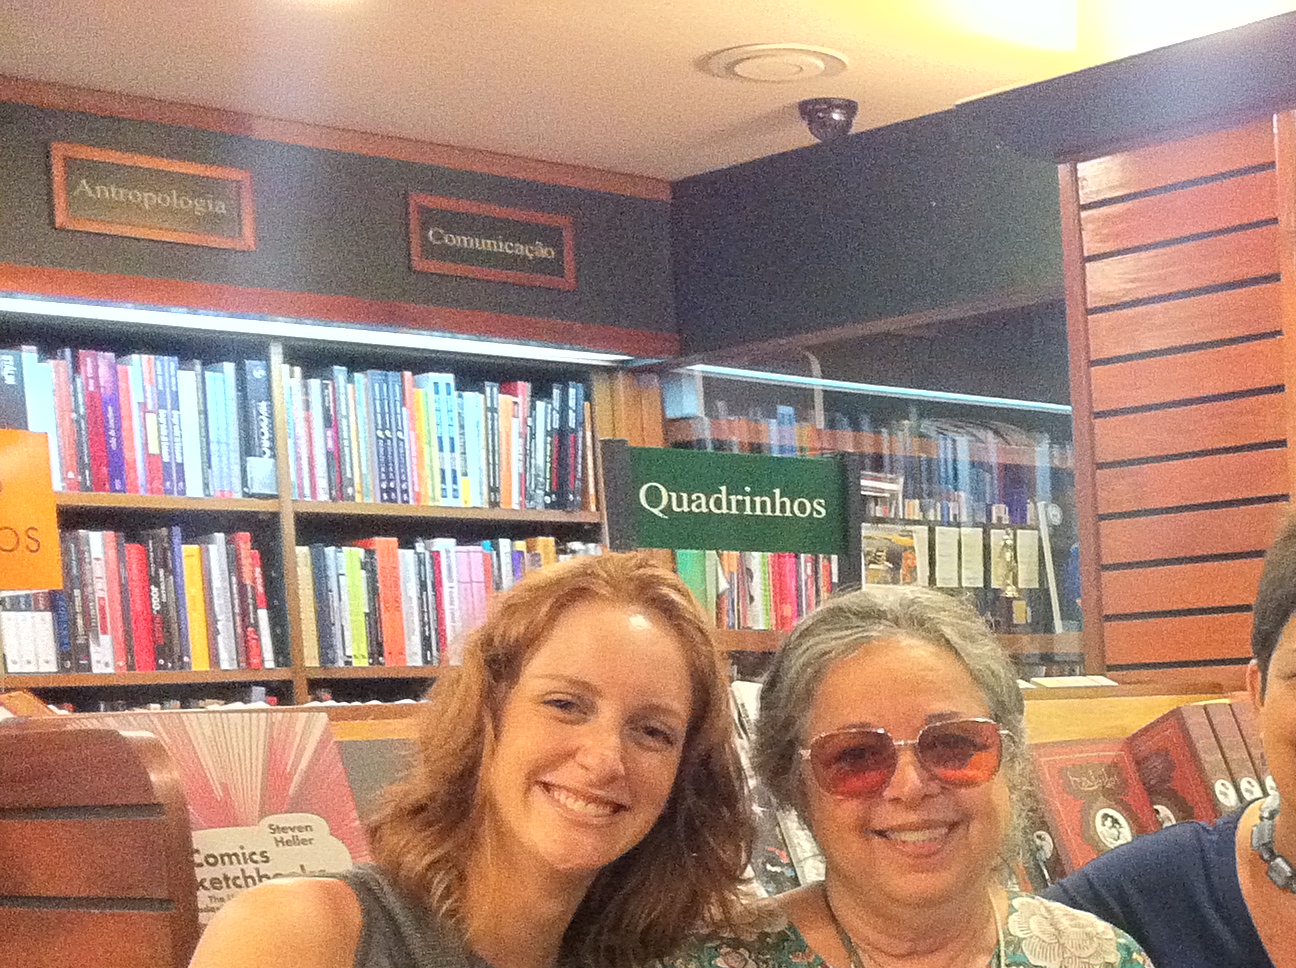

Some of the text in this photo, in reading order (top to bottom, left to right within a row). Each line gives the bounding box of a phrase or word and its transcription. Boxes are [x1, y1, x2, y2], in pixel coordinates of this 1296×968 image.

[73, 179, 227, 216] Antropologia
[428, 226, 555, 260] Comunicação
[638, 482, 827, 519] Quadrinhos
[268, 823, 313, 835] Steven
[274, 835, 315, 848] Heller
